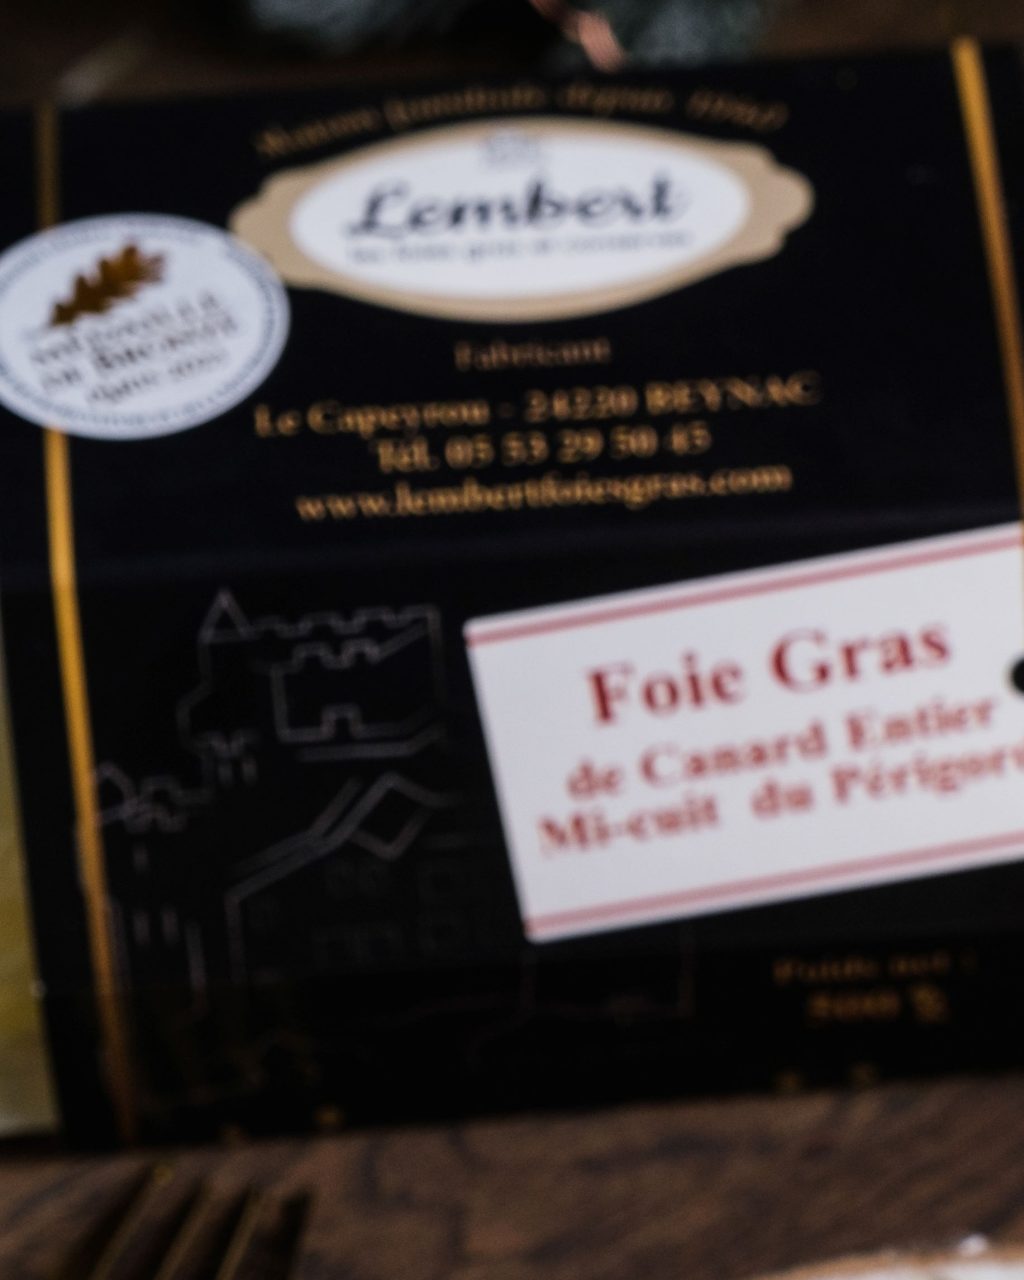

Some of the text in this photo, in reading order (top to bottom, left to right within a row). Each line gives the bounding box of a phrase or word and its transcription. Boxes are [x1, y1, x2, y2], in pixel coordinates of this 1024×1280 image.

[343, 170, 685, 238] Lembert
[254, 403, 301, 437] Le
[645, 371, 822, 415] BEYNAC
[445, 434, 496, 470] 05
[584, 621, 953, 726] Foie Gras
[566, 696, 997, 801] de Canard Entier
[537, 795, 720, 858] Mi-cuit
[751, 779, 815, 821] du
